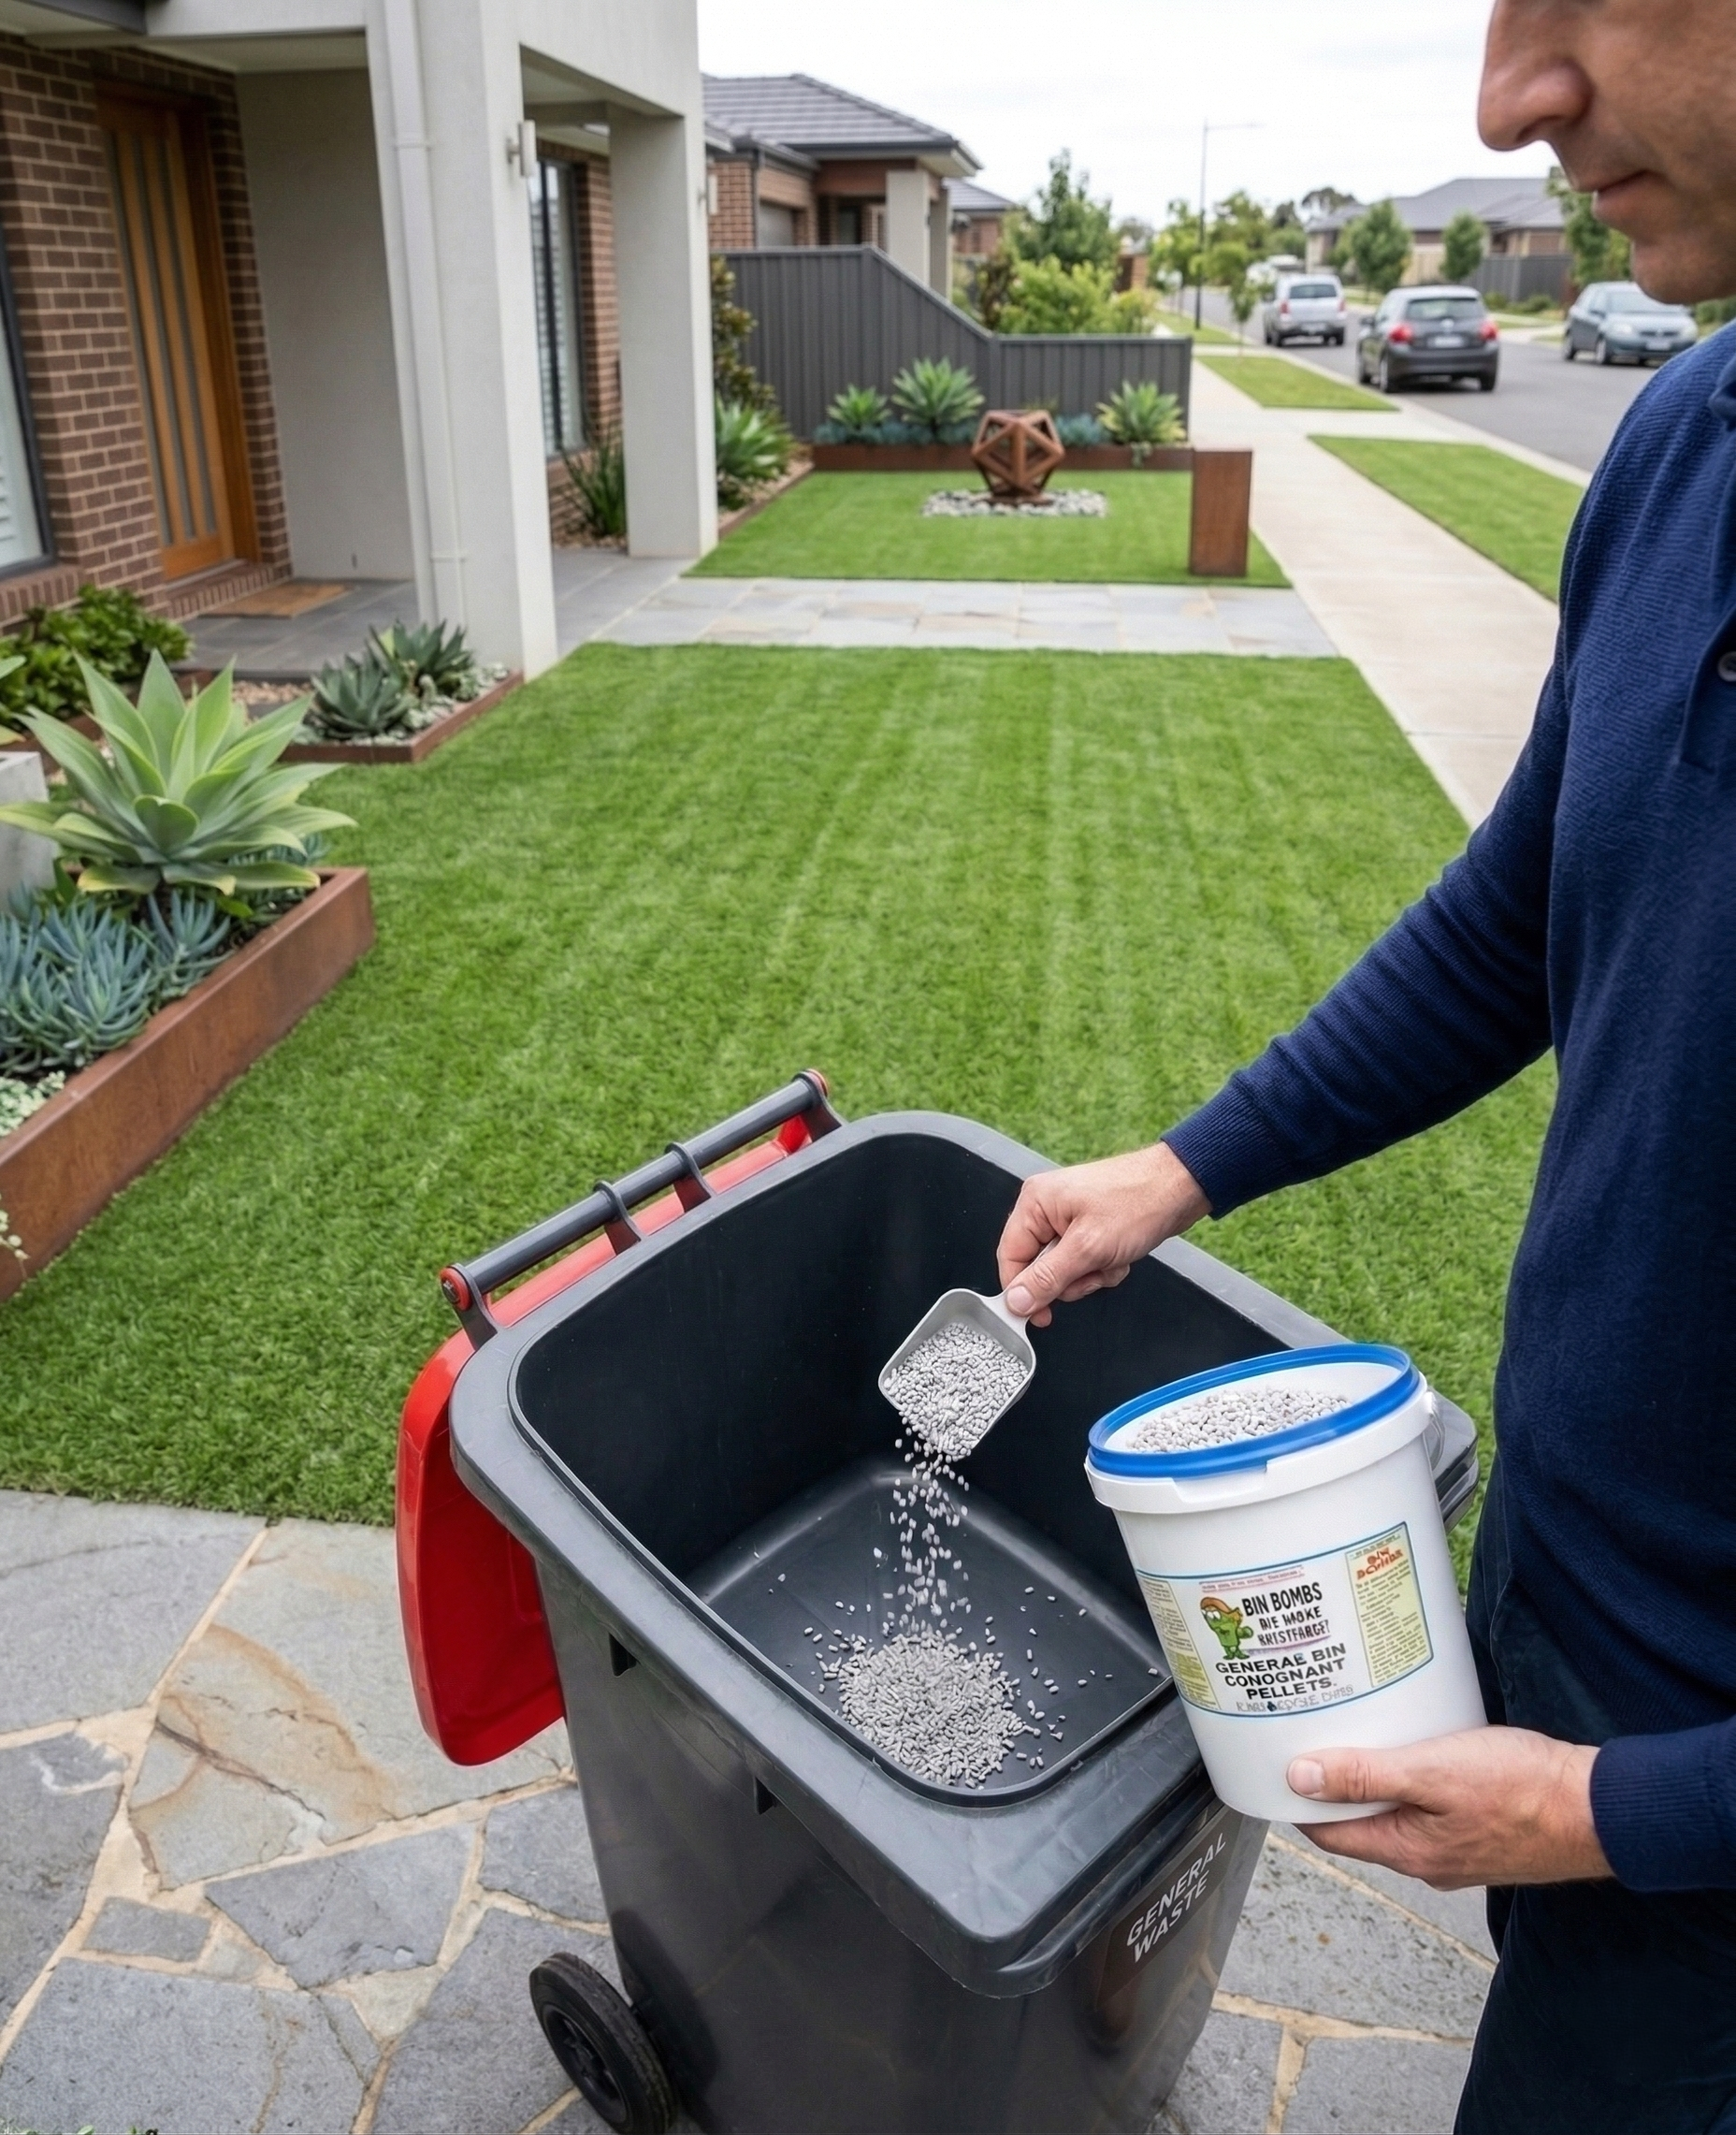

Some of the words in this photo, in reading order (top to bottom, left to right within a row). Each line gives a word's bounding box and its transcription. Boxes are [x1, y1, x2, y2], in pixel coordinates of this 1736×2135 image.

[1242, 1594, 1269, 1617] BIN
[1270, 1582, 1323, 1612] BOMBS
[1311, 1643, 1346, 1662] BIN
[1224, 1658, 1345, 1687] CONOGNANT
[1127, 1833, 1226, 1947] GENERAL
[1135, 1869, 1209, 1963] WASTE
